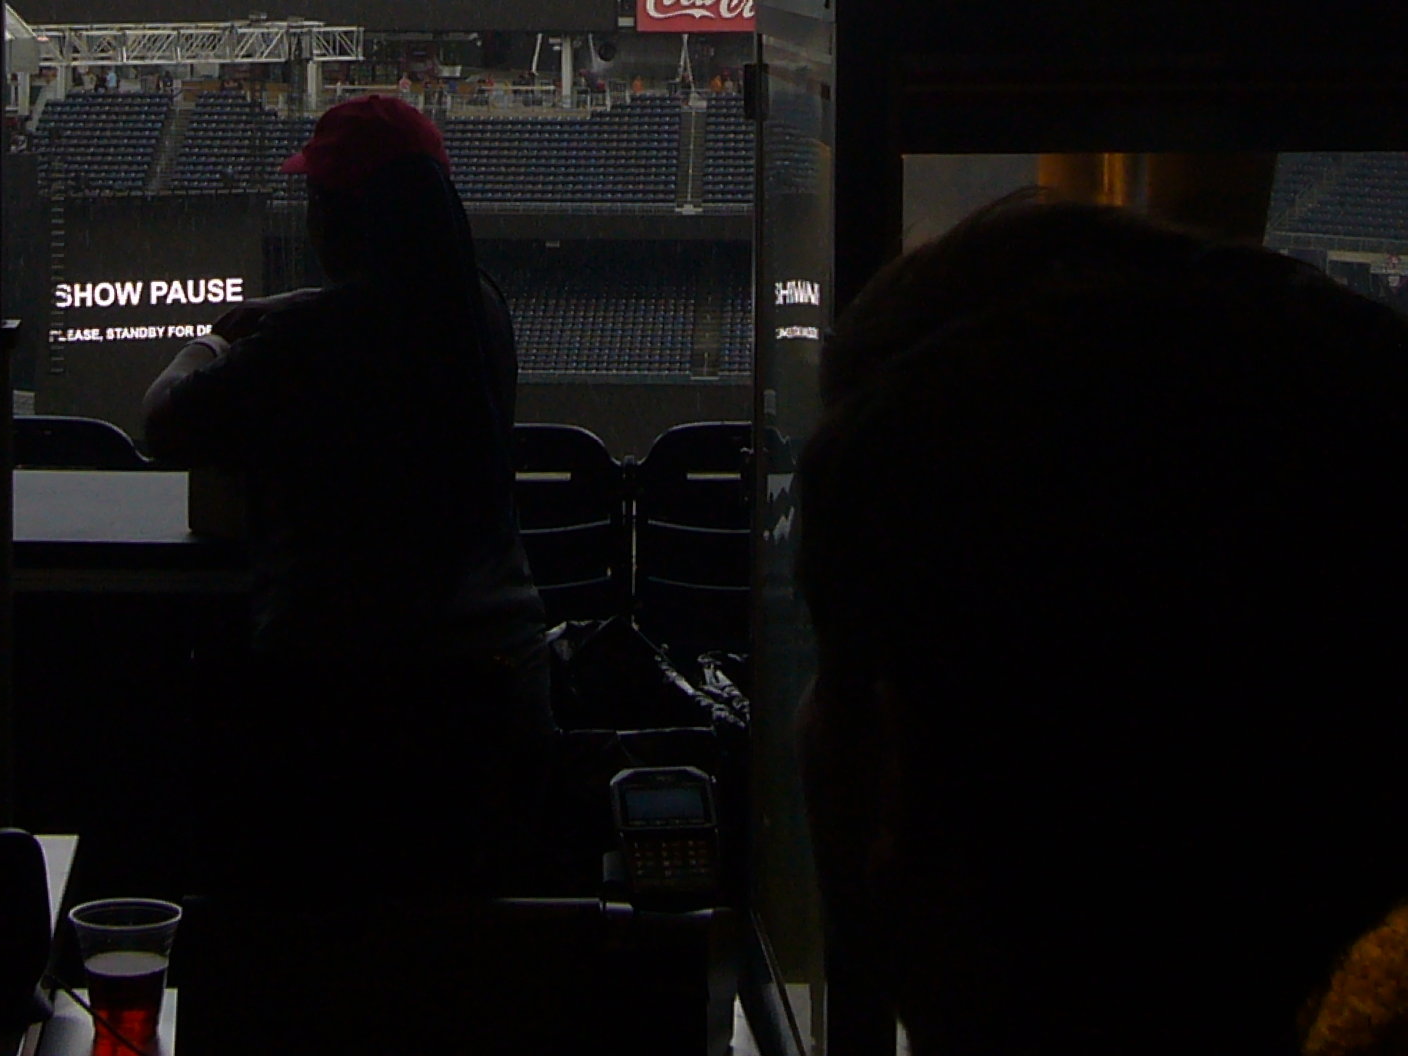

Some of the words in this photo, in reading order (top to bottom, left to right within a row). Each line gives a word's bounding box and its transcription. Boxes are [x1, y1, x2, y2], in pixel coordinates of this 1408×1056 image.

[55, 281, 143, 308] SHOW
[150, 278, 244, 305] PAUSE
[106, 326, 166, 341] STANDBY
[168, 325, 195, 339] FOR
